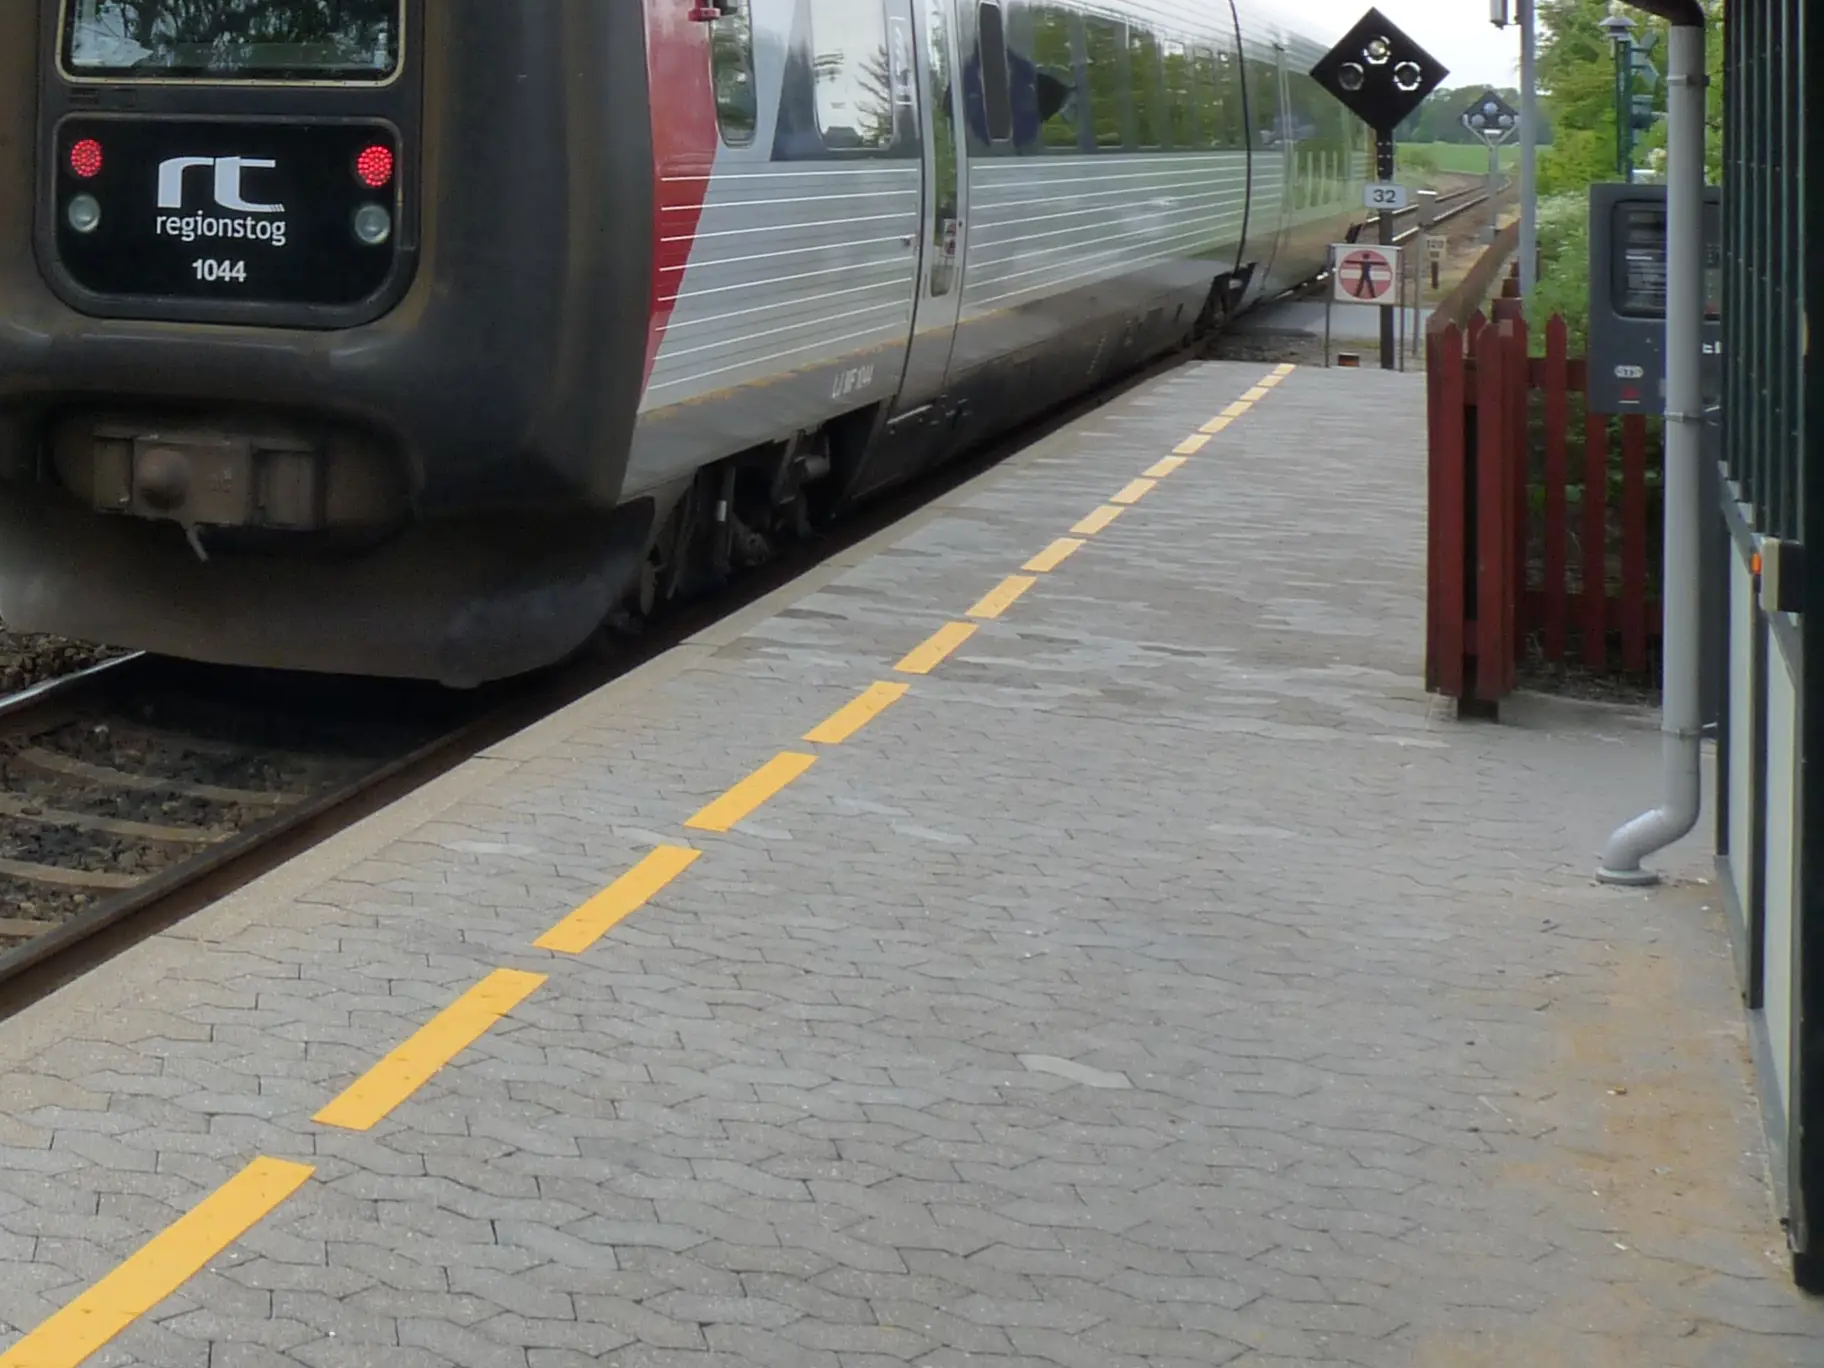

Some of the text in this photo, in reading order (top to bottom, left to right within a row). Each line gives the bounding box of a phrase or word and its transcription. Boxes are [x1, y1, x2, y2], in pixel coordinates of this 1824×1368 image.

[1373, 189, 1396, 203] 32
[156, 210, 286, 246] regionstog
[192, 258, 247, 282] 1044
